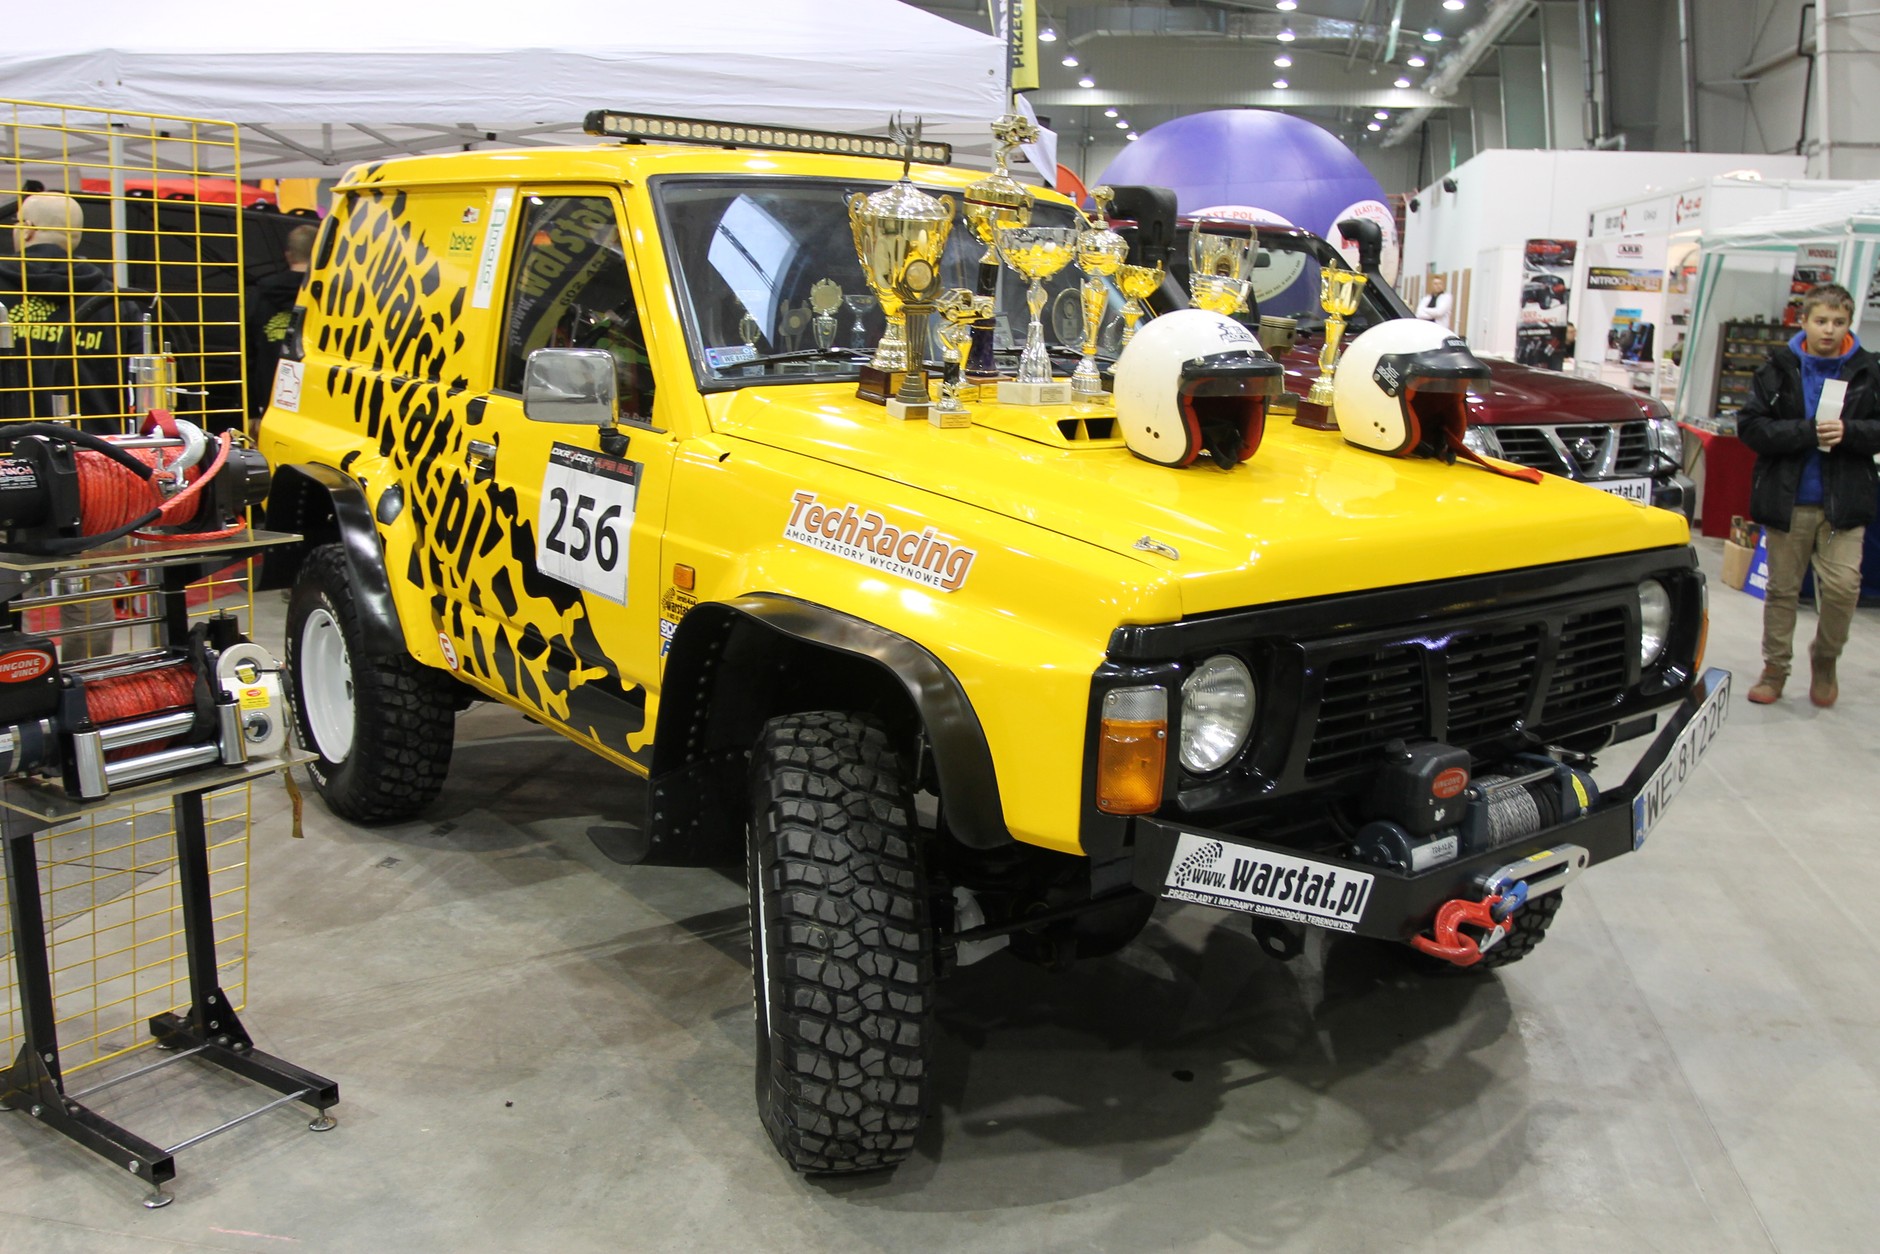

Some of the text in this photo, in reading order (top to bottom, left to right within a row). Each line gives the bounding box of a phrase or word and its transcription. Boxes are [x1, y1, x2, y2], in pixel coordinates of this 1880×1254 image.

[545, 486, 623, 572] 256
[785, 528, 941, 586] AMORTYZATORY WYCZYNOWE
[789, 492, 975, 590] TechRacing
[1647, 686, 1727, 827] WE 8122P
[1218, 897, 1255, 911] NAPRAWY
[1307, 914, 1354, 931] TERENOWYCH
